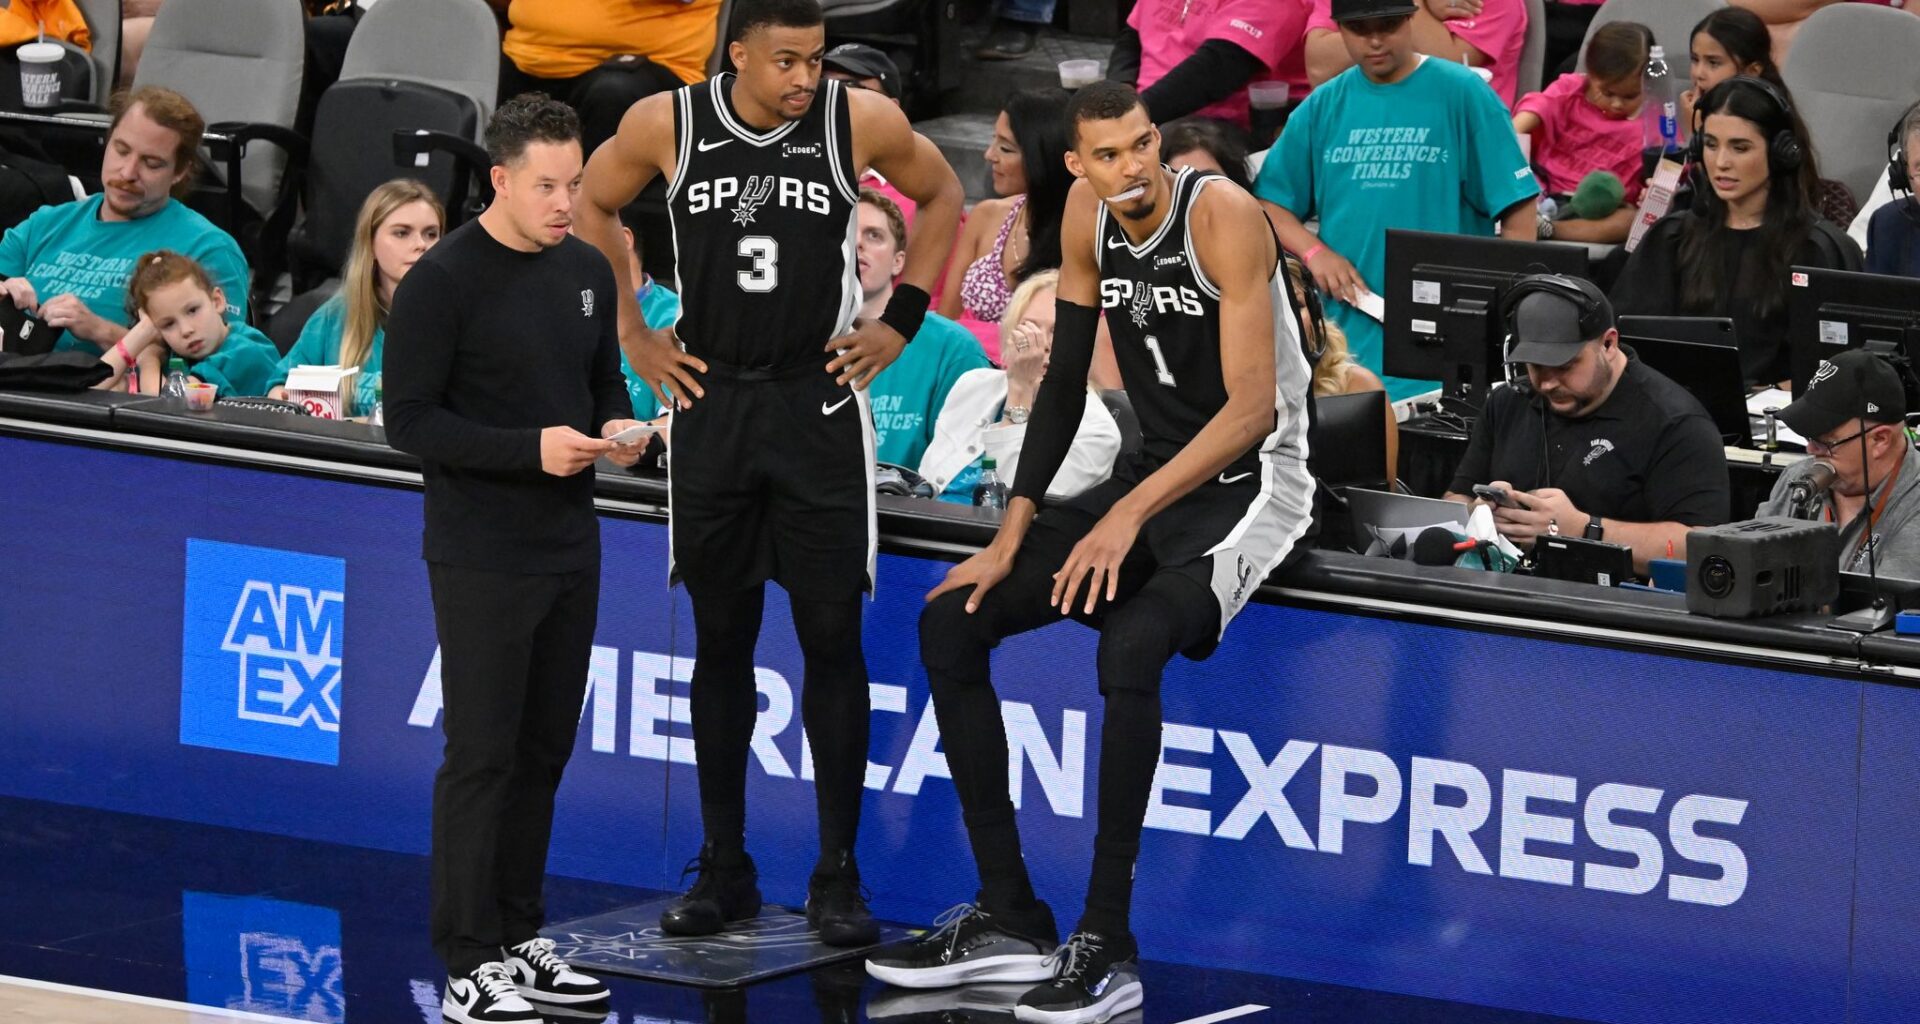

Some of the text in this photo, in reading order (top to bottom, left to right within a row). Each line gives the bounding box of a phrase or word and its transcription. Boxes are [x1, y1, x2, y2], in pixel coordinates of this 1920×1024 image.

[1348, 127, 1430, 145] WESTERN
[787, 146, 817, 154] LEDGER
[1331, 145, 1441, 163] CONFERENCE
[1352, 163, 1412, 180] FINALS
[688, 175, 831, 228] SPURS
[736, 235, 779, 293] 3
[1156, 256, 1182, 266] LEDGER
[42, 279, 106, 299] FINALS
[1144, 334, 1177, 388] 1
[1143, 721, 1749, 907] EXPRESS
